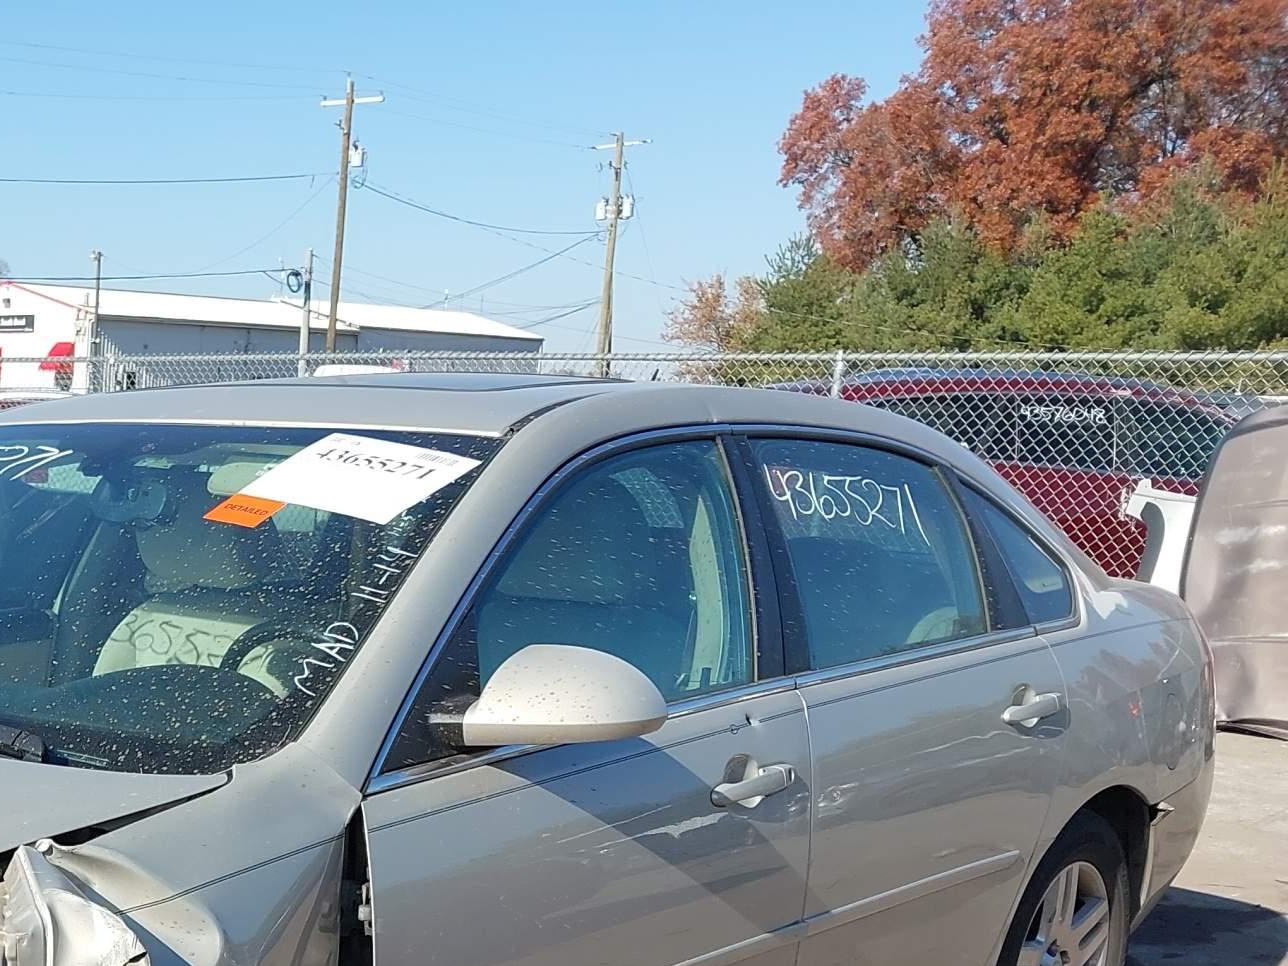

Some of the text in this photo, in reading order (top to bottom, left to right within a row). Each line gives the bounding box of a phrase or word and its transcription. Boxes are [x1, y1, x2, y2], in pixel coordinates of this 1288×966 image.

[316, 448, 436, 480] 43655271
[223, 503, 269, 516] DETAILED
[763, 463, 931, 546] 43655271
[294, 622, 359, 697] MAD
